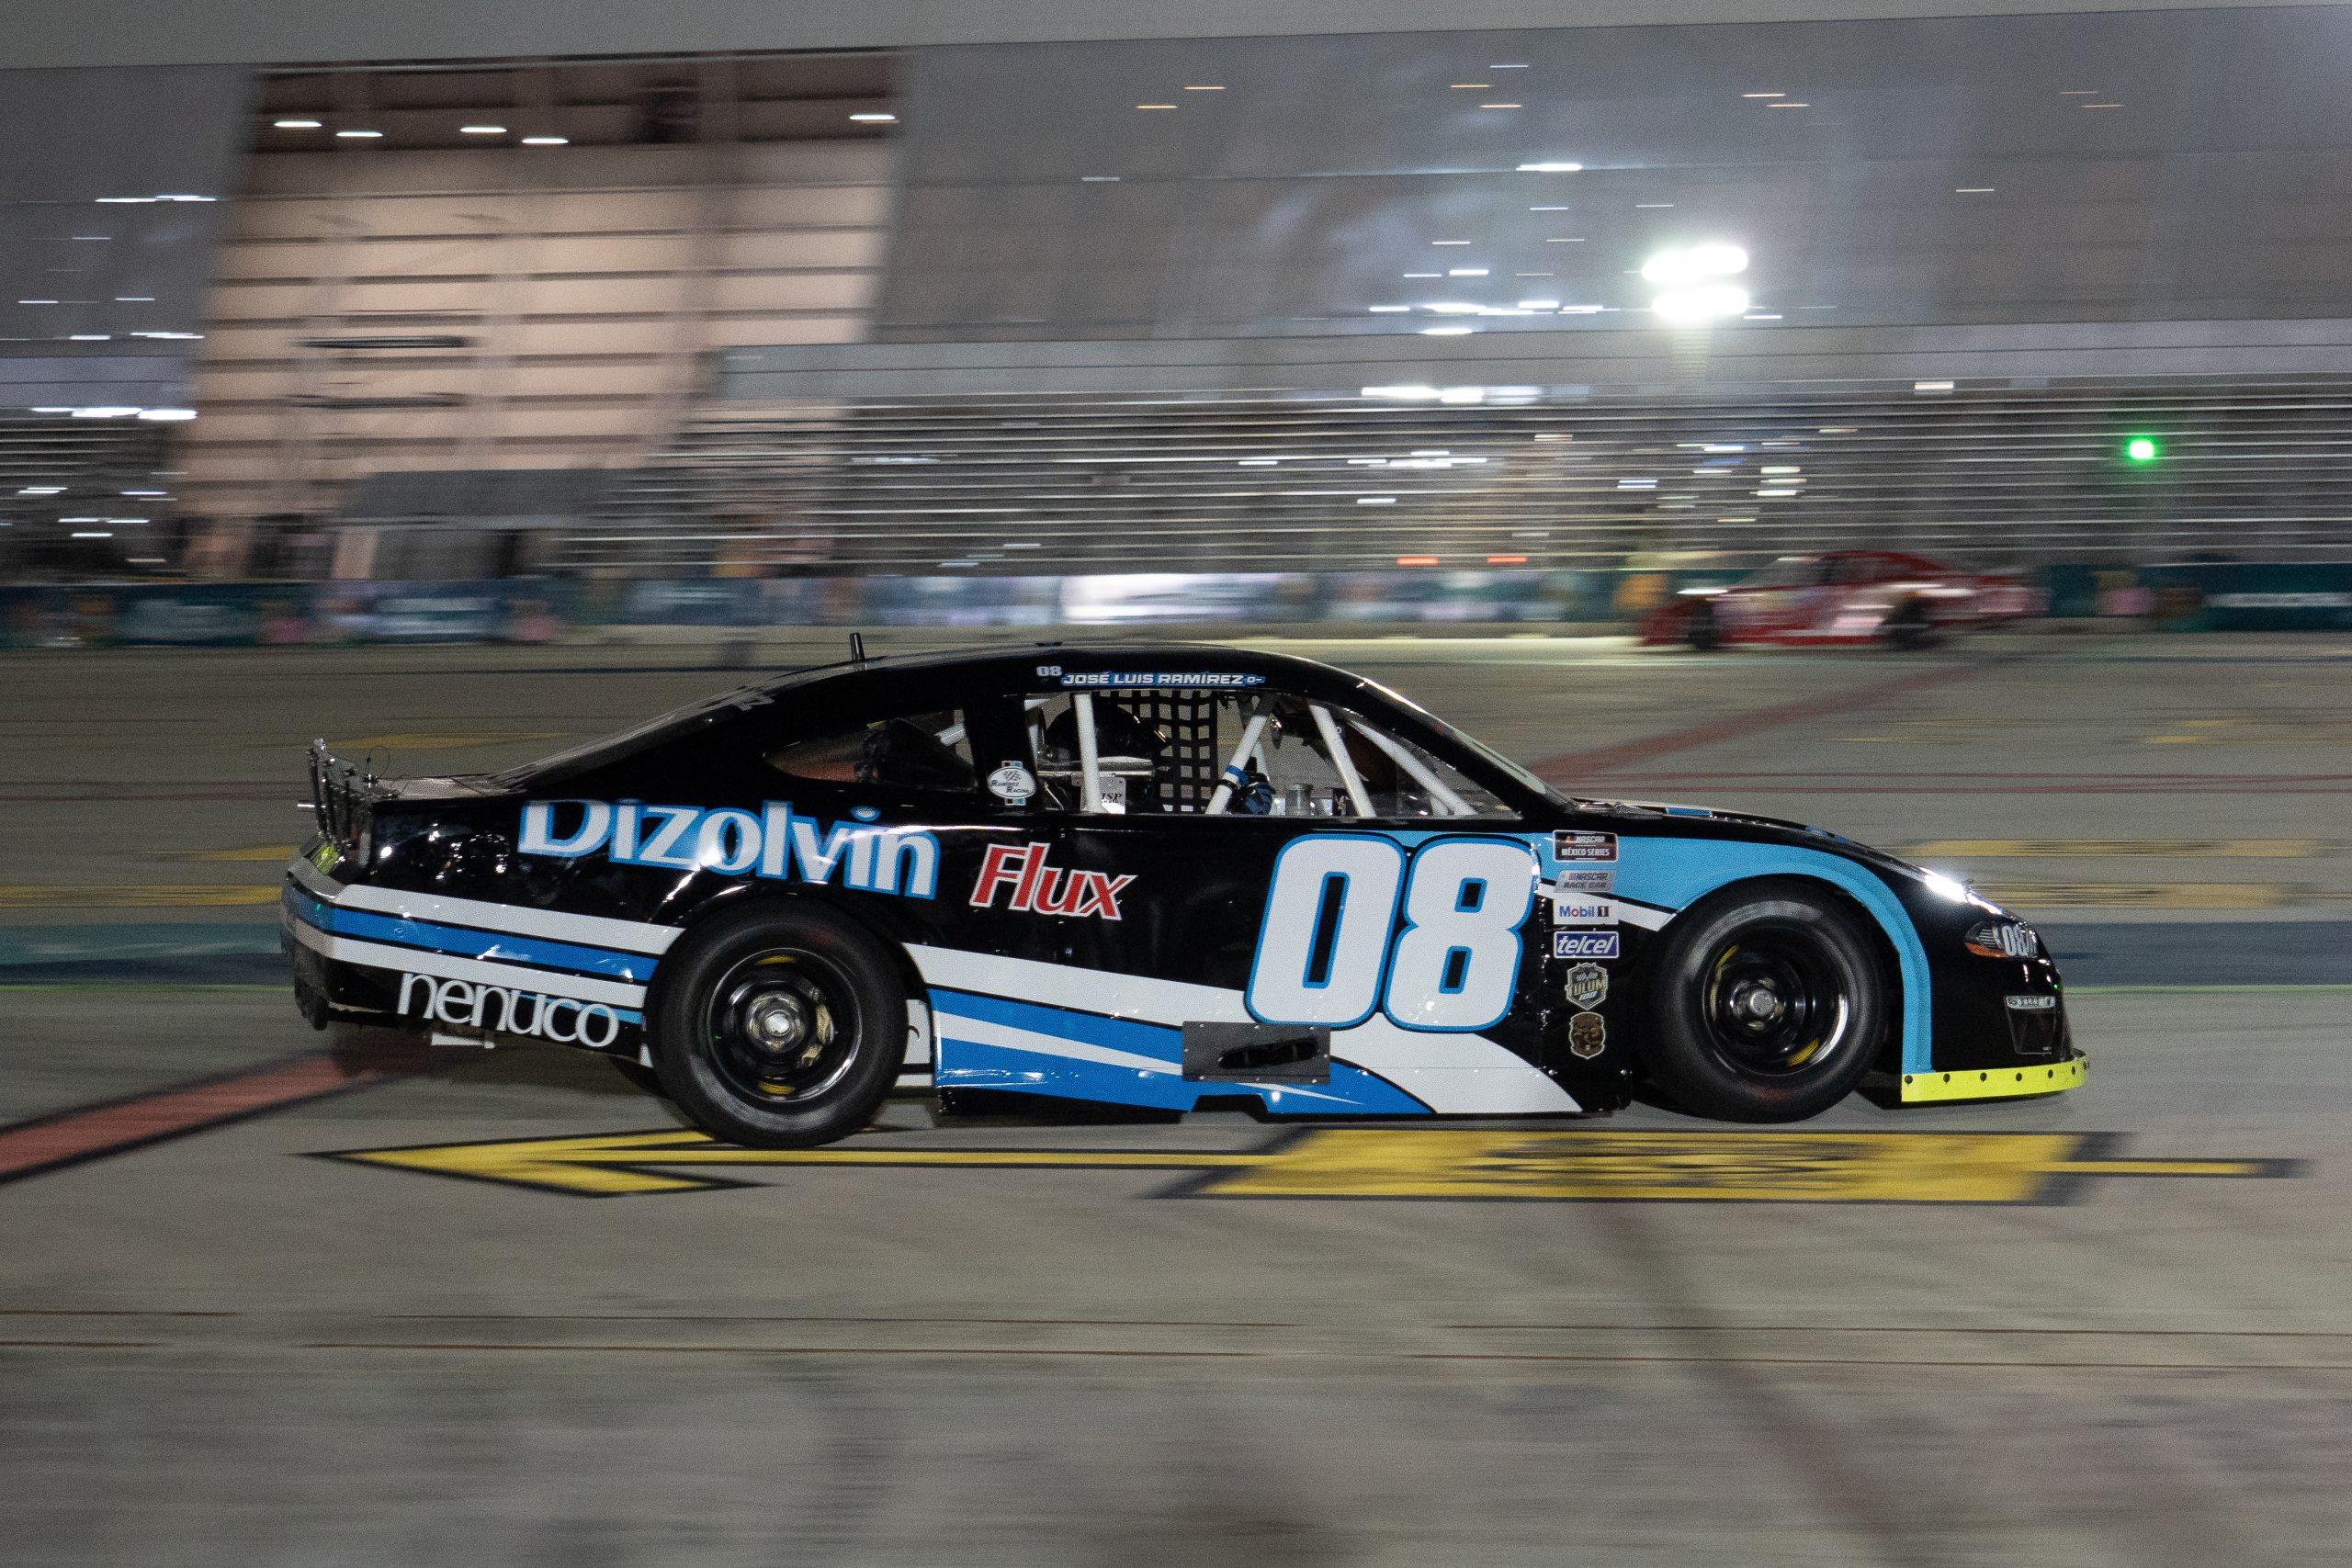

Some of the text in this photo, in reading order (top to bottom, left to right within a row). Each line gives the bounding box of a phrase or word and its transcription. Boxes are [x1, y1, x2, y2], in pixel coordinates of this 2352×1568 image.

[1036, 666, 1062, 676] 08
[1064, 671, 1110, 684] JOSÉ
[1114, 673, 1155, 684] LUIS
[1574, 835, 1606, 843] NASCAR
[518, 798, 941, 899] Dizolvin
[1561, 846, 1610, 856] MÉXICO SERIES
[969, 841, 1138, 920] Flux
[1574, 872, 1609, 881] NASCAR
[1559, 905, 1610, 918] Mobil 1
[1245, 833, 1538, 1033] 08
[1556, 935, 1616, 954] telcel
[1565, 976, 1608, 998] TULUM
[1578, 990, 1598, 1001] 100
[397, 973, 619, 1047] nenuco
